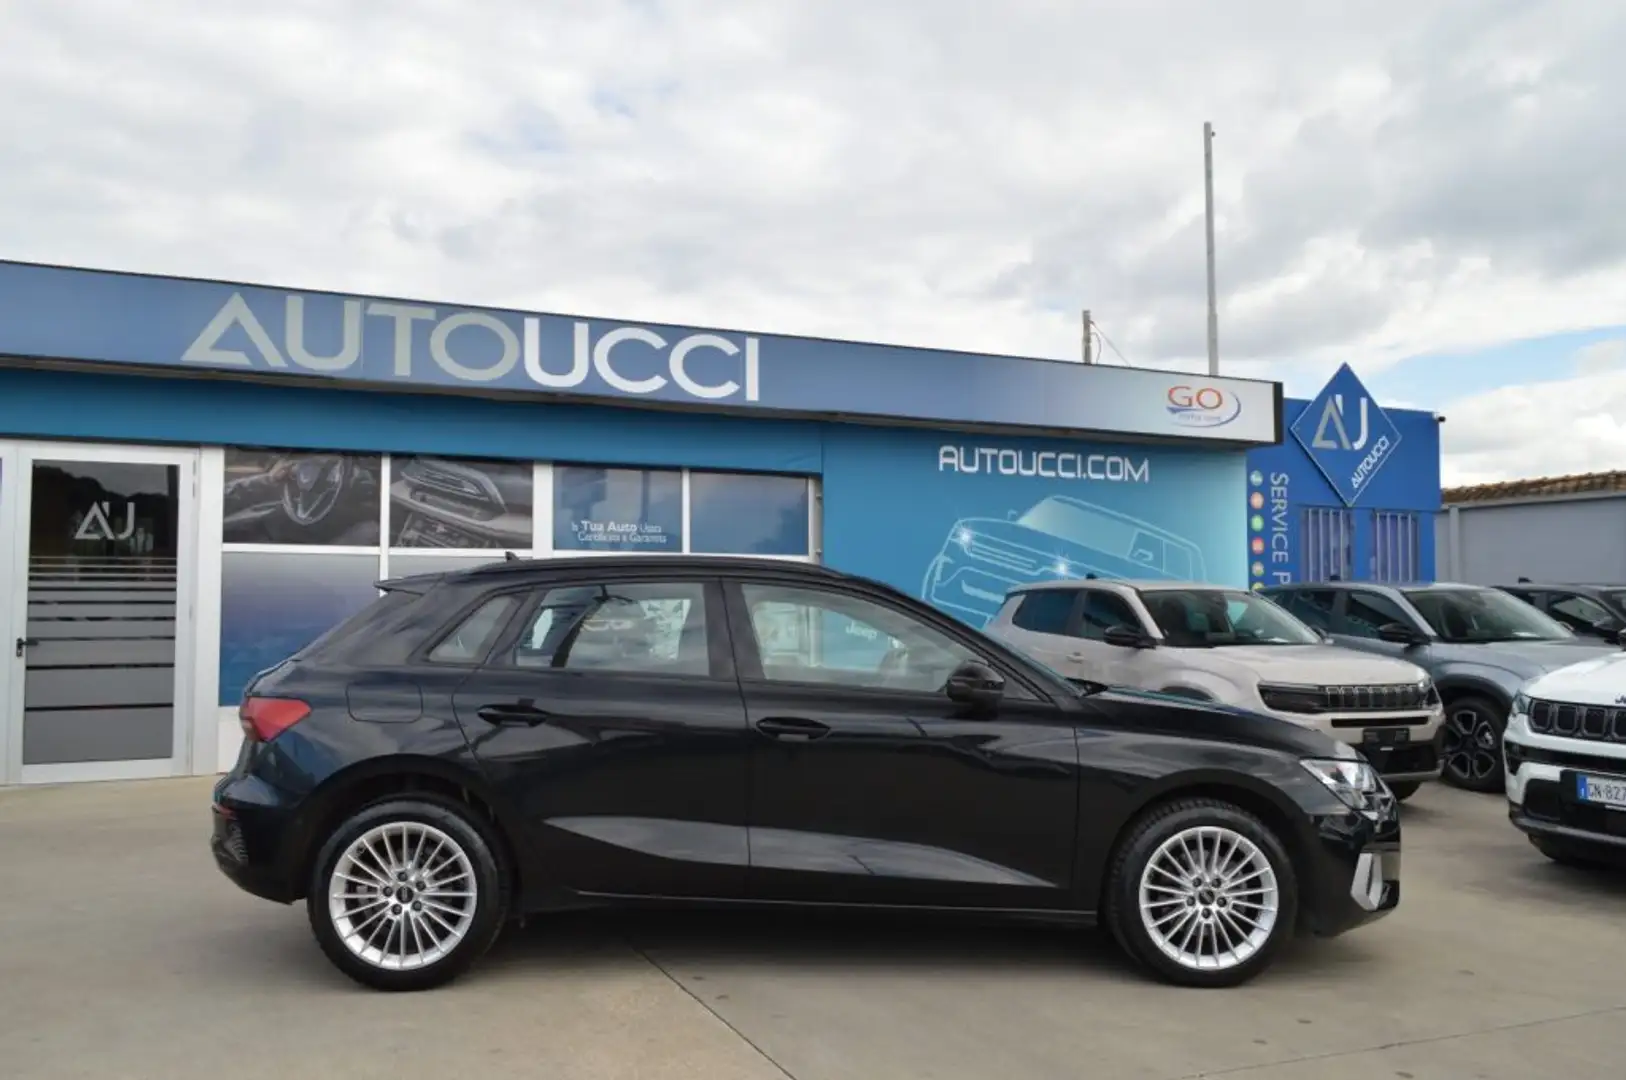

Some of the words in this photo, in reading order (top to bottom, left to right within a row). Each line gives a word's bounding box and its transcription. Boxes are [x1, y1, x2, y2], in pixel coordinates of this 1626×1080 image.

[180, 291, 759, 401] AUTOUCCI
[1168, 385, 1223, 410] GO
[938, 445, 1149, 483] AUTOUCCI.COM
[1351, 435, 1390, 489] AUTOUCCI
[581, 520, 604, 532] Tua
[607, 521, 637, 532] Auto
[1270, 472, 1290, 563] SERVICE
